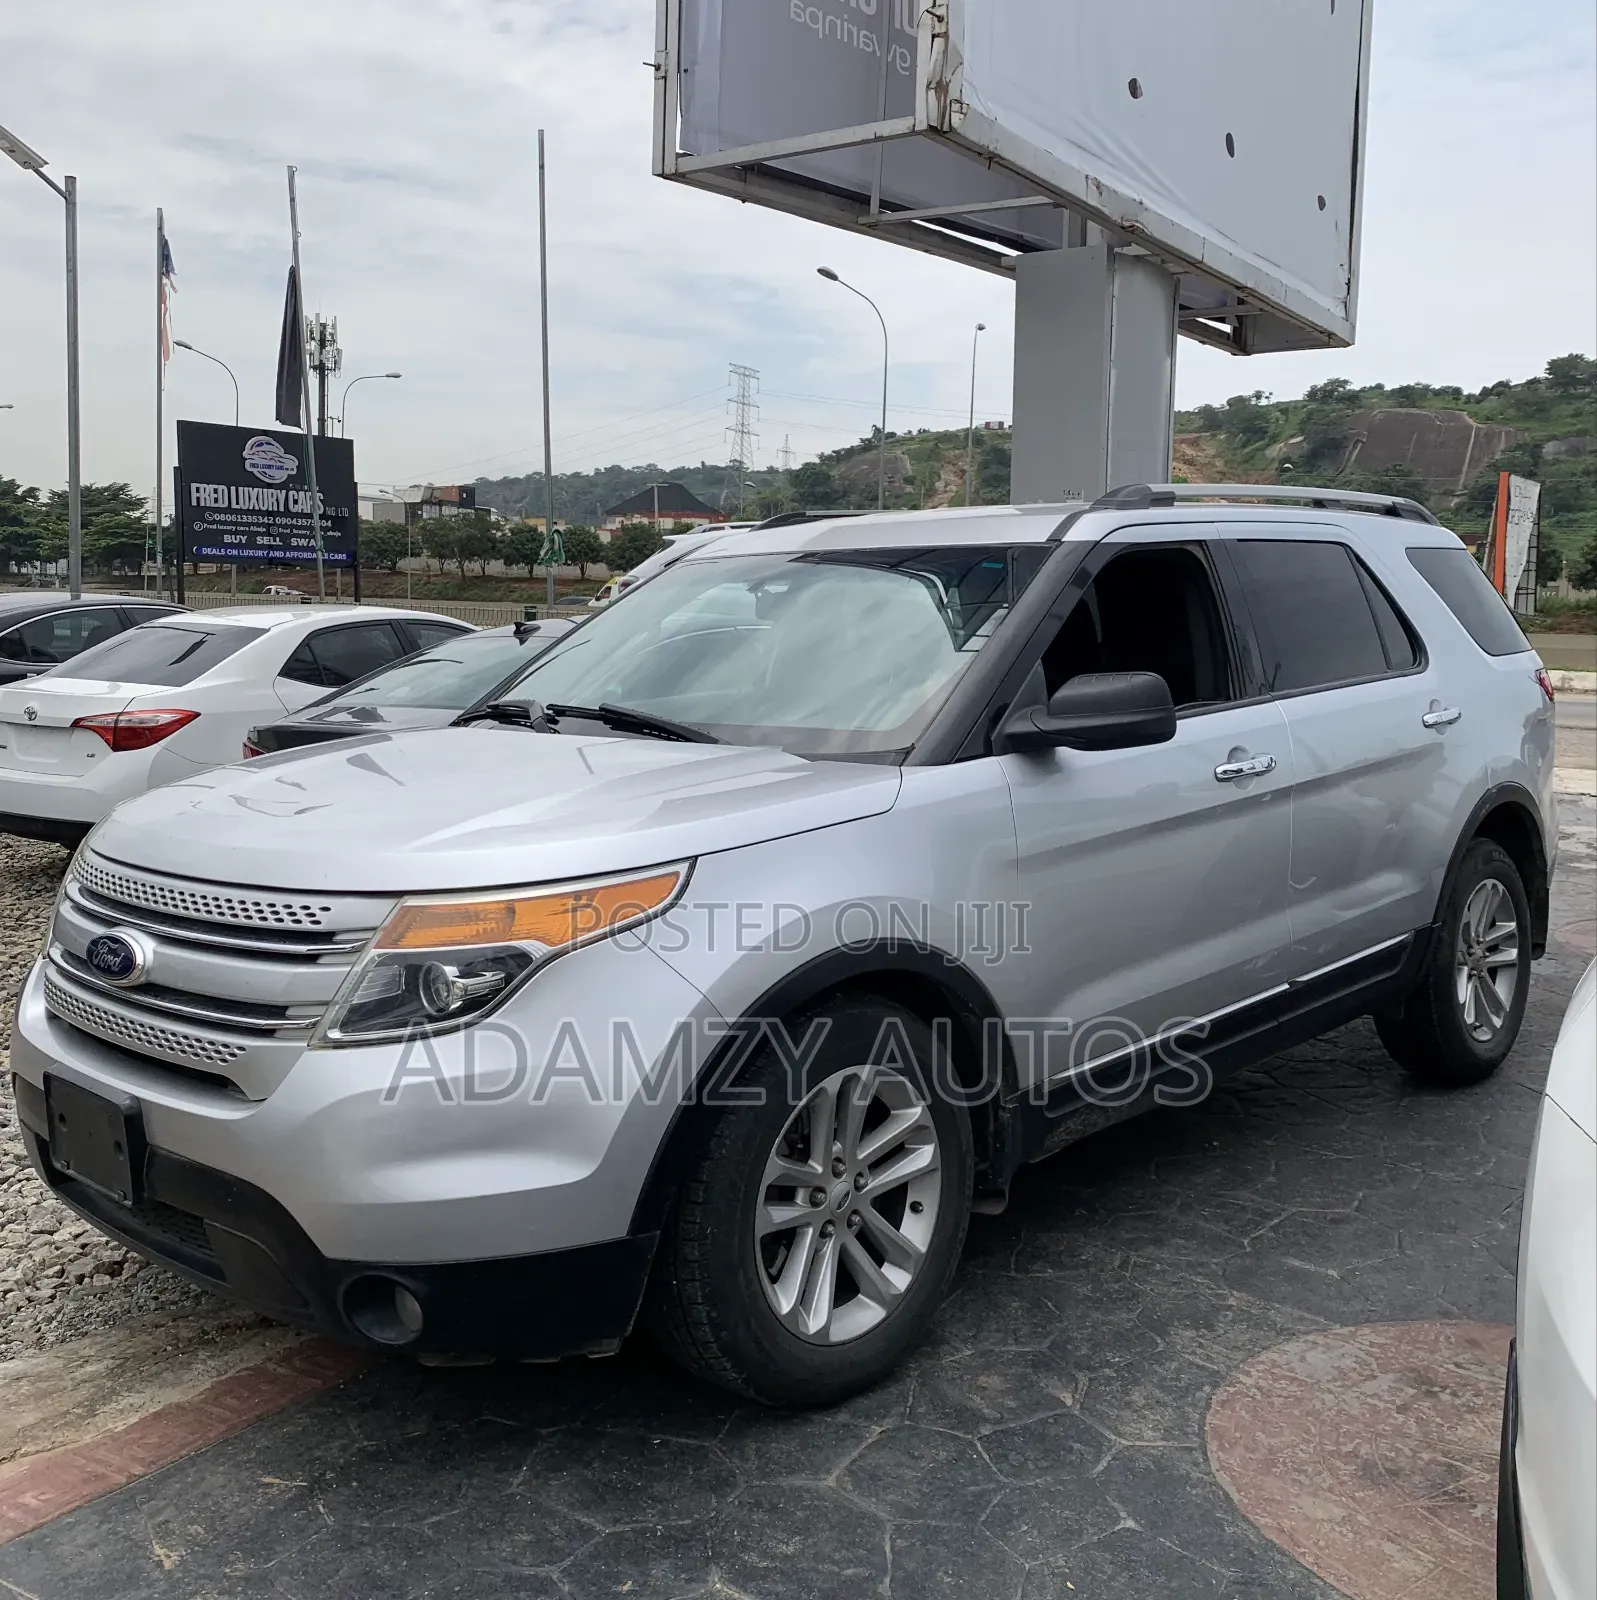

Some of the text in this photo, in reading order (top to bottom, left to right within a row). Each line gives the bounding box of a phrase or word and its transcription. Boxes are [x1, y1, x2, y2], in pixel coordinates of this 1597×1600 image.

[190, 482, 229, 508] FRED
[230, 486, 287, 512] LUXURY
[338, 507, 349, 517] LTD
[214, 513, 332, 528] 08061335342 0904357504
[223, 534, 320, 547] BUY SELL SWA
[202, 547, 226, 555] DEALS
[226, 548, 238, 556] ON
[239, 549, 268, 557] LUXURY
[285, 552, 328, 560] AFFORDALE
[92, 938, 125, 972] Ford
